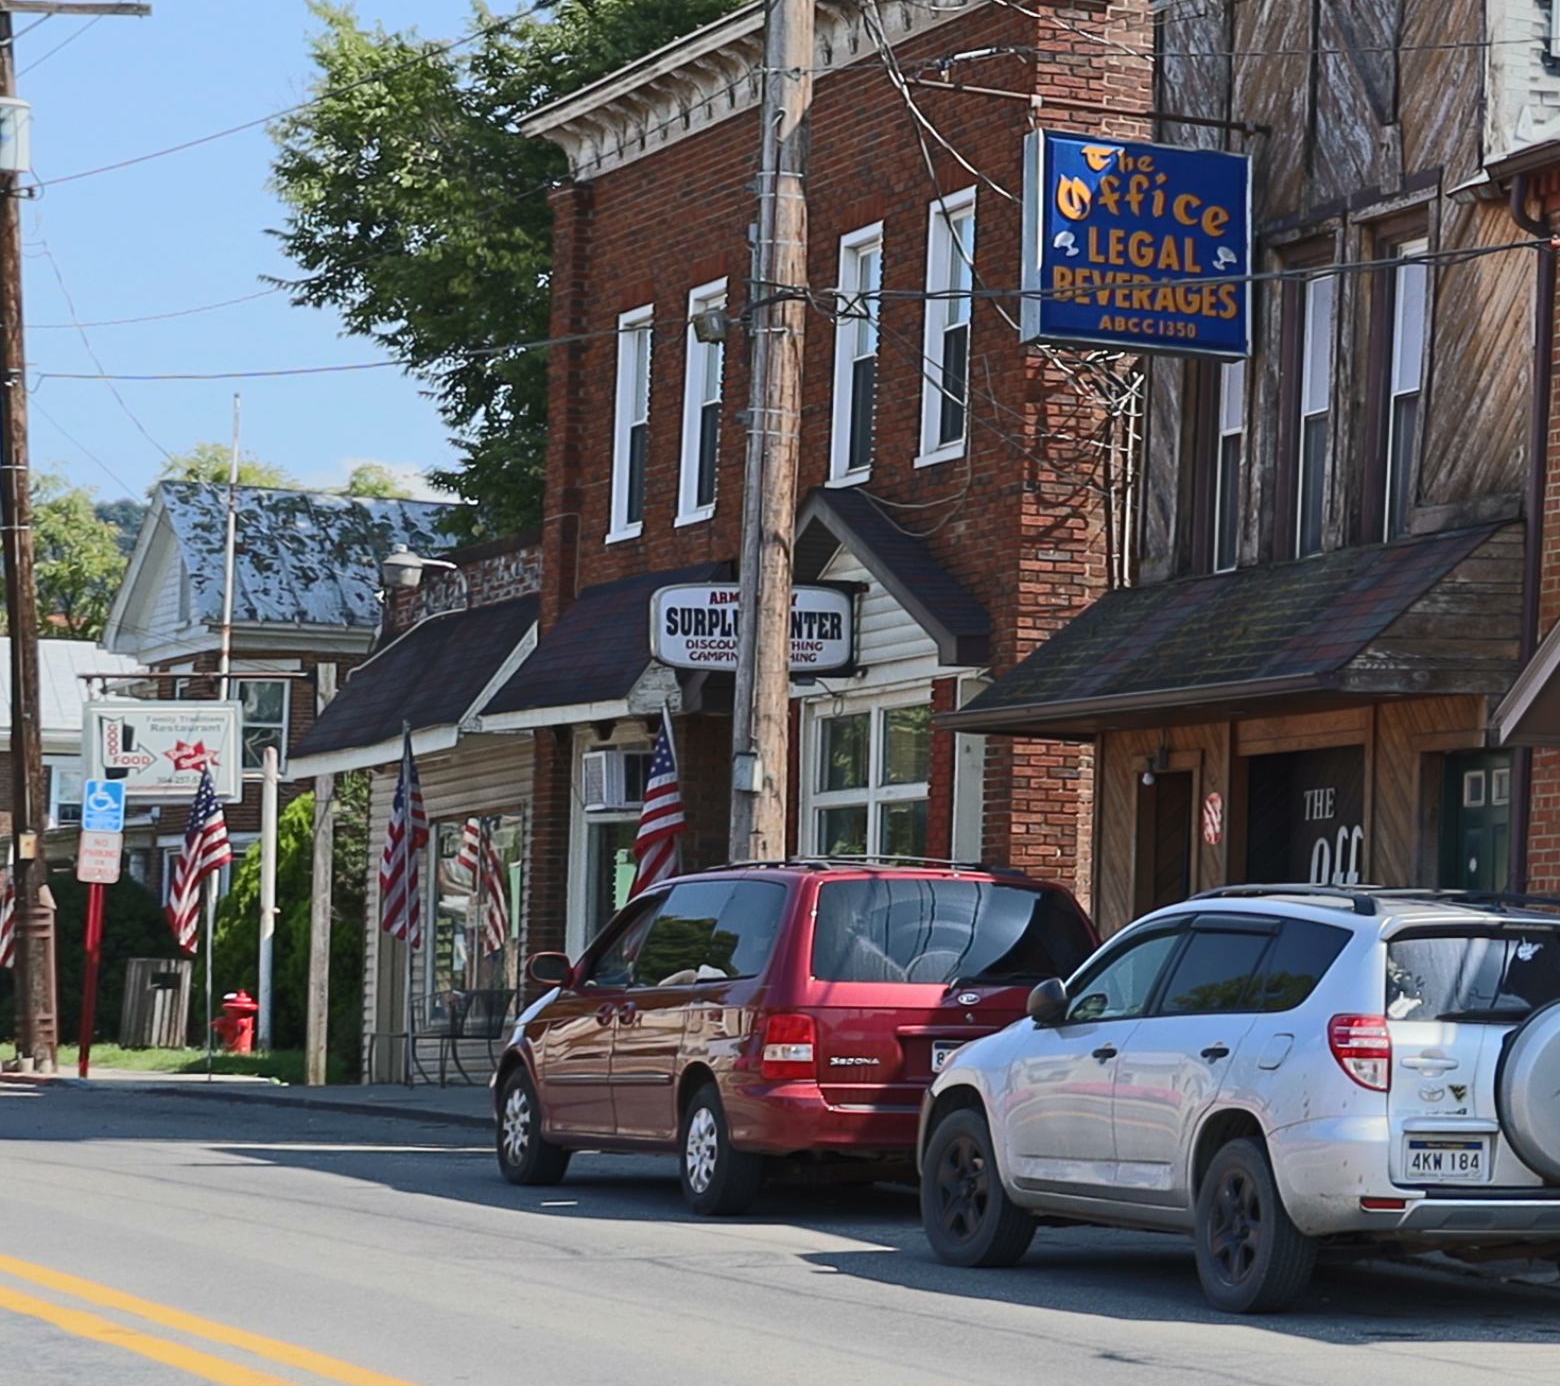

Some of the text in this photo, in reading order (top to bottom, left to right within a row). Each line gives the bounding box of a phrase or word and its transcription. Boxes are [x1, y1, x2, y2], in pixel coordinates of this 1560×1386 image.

[1081, 145, 1156, 173] The
[1057, 173, 1231, 238] Office
[1088, 226, 1203, 274] LEGAL
[1052, 265, 1239, 320] BEVERAGES
[1098, 314, 1197, 339] ABCC 1350
[709, 591, 740, 605] ARM
[666, 606, 843, 640] SURPL NTER
[686, 639, 737, 650] DISCOU
[689, 650, 738, 662] CAMPIN
[107, 724, 119, 756] GOOD
[150, 724, 222, 732] Restaurant
[113, 755, 151, 765] FOOD
[1304, 787, 1337, 821] THE
[1411, 1152, 1479, 1171] 4KW 184
